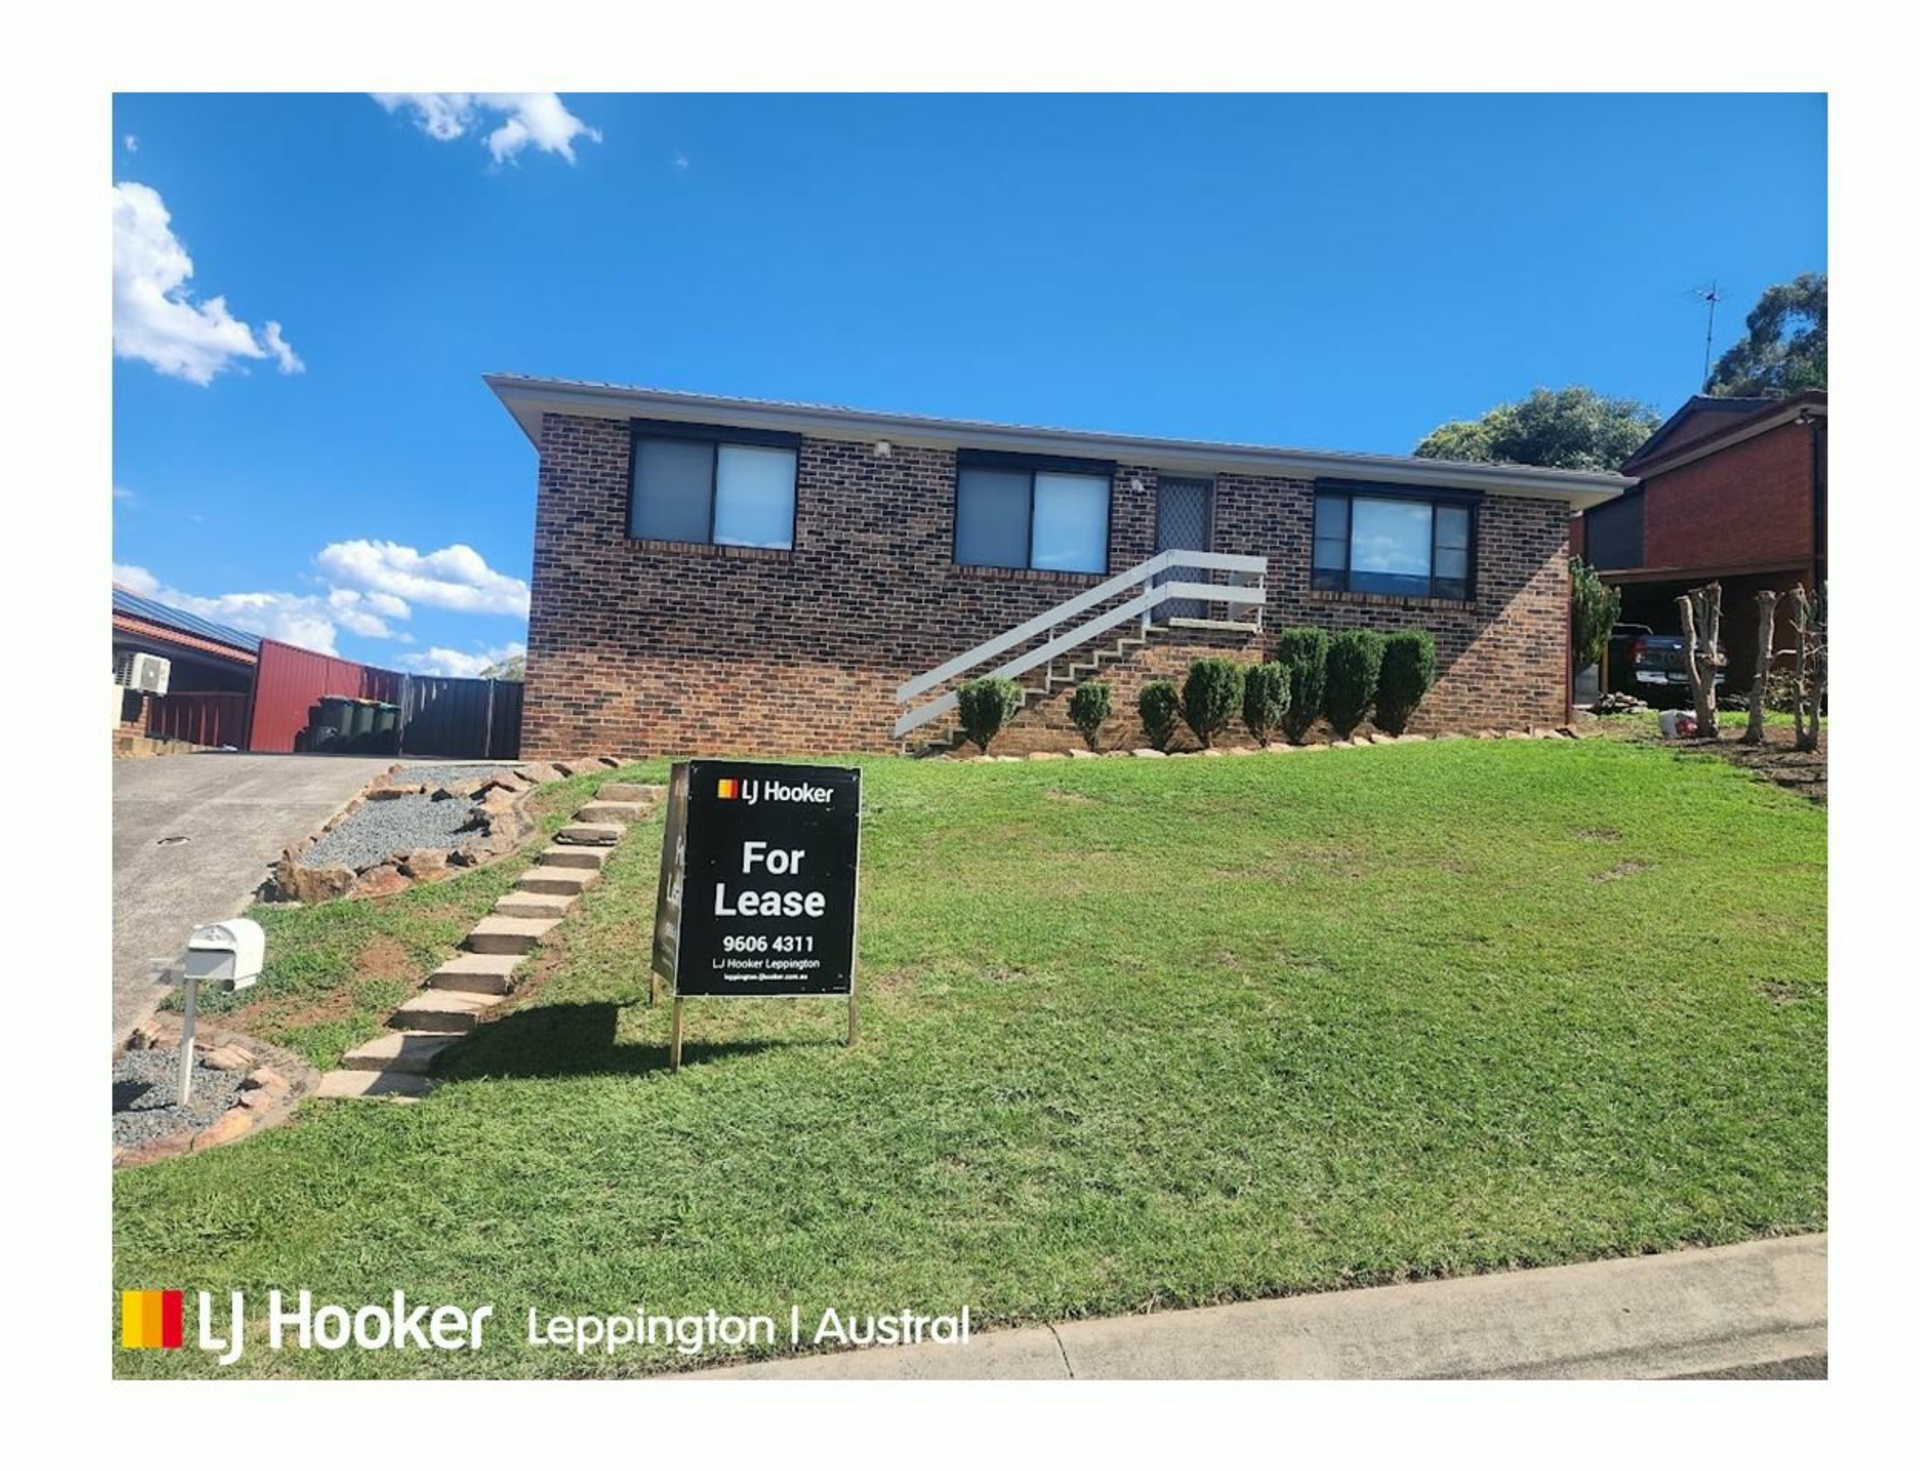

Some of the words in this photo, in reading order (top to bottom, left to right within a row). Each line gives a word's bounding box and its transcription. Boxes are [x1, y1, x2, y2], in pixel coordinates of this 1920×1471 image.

[741, 779, 759, 806] LJ
[764, 780, 835, 803] Hooker
[742, 841, 805, 875] For
[714, 882, 826, 917] Lease
[722, 935, 769, 953] 9606
[771, 935, 814, 953] 4311
[712, 958, 726, 970] LJ
[727, 958, 764, 970] Hooker
[765, 958, 821, 971] Leppington
